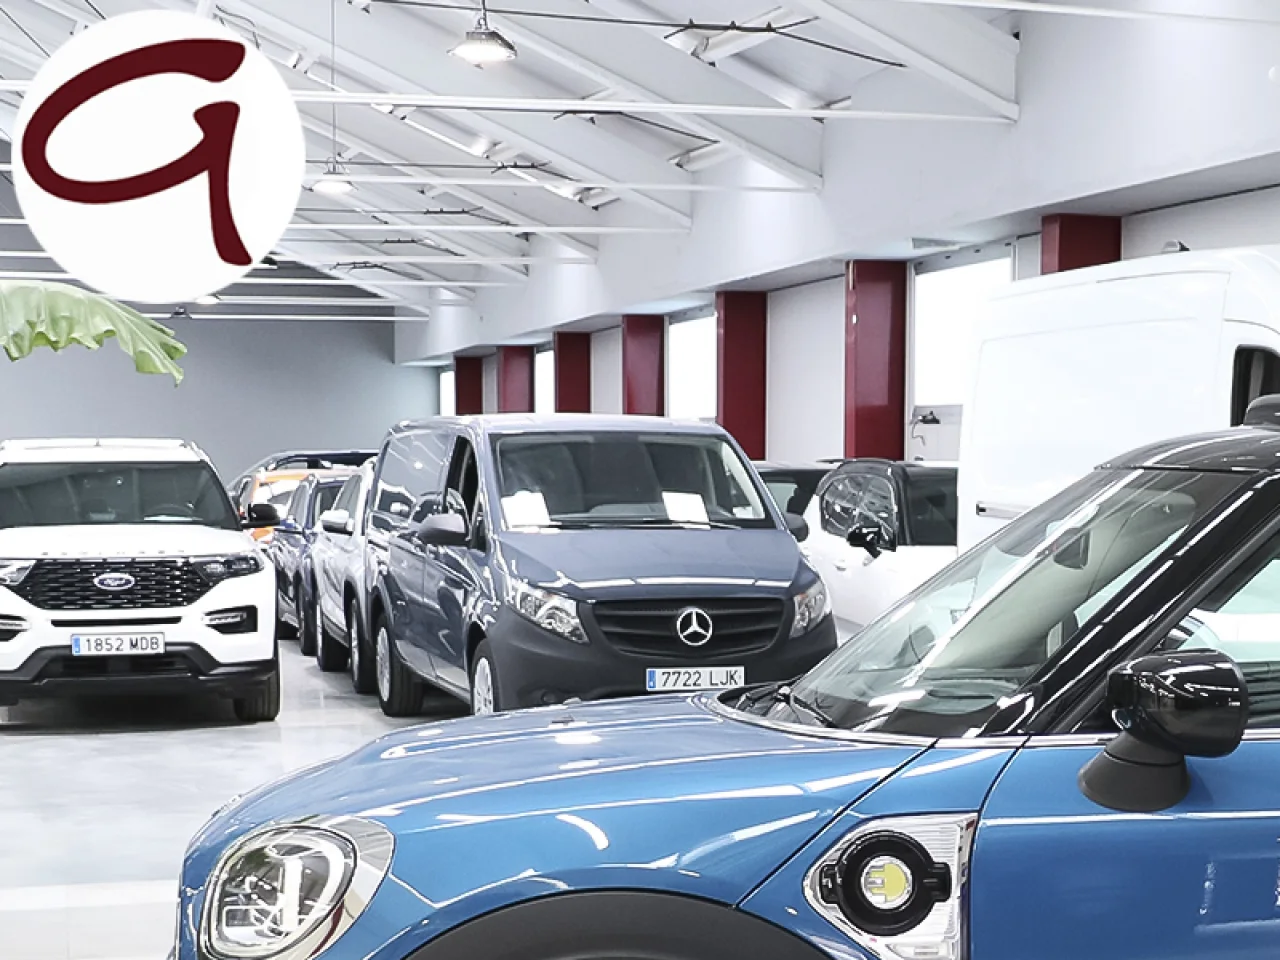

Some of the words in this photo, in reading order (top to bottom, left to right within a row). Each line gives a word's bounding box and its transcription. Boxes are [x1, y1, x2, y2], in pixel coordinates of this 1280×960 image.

[85, 637, 124, 652] 1852
[129, 636, 159, 651] MDB
[661, 670, 702, 687] 7722
[709, 669, 739, 686] LJK
